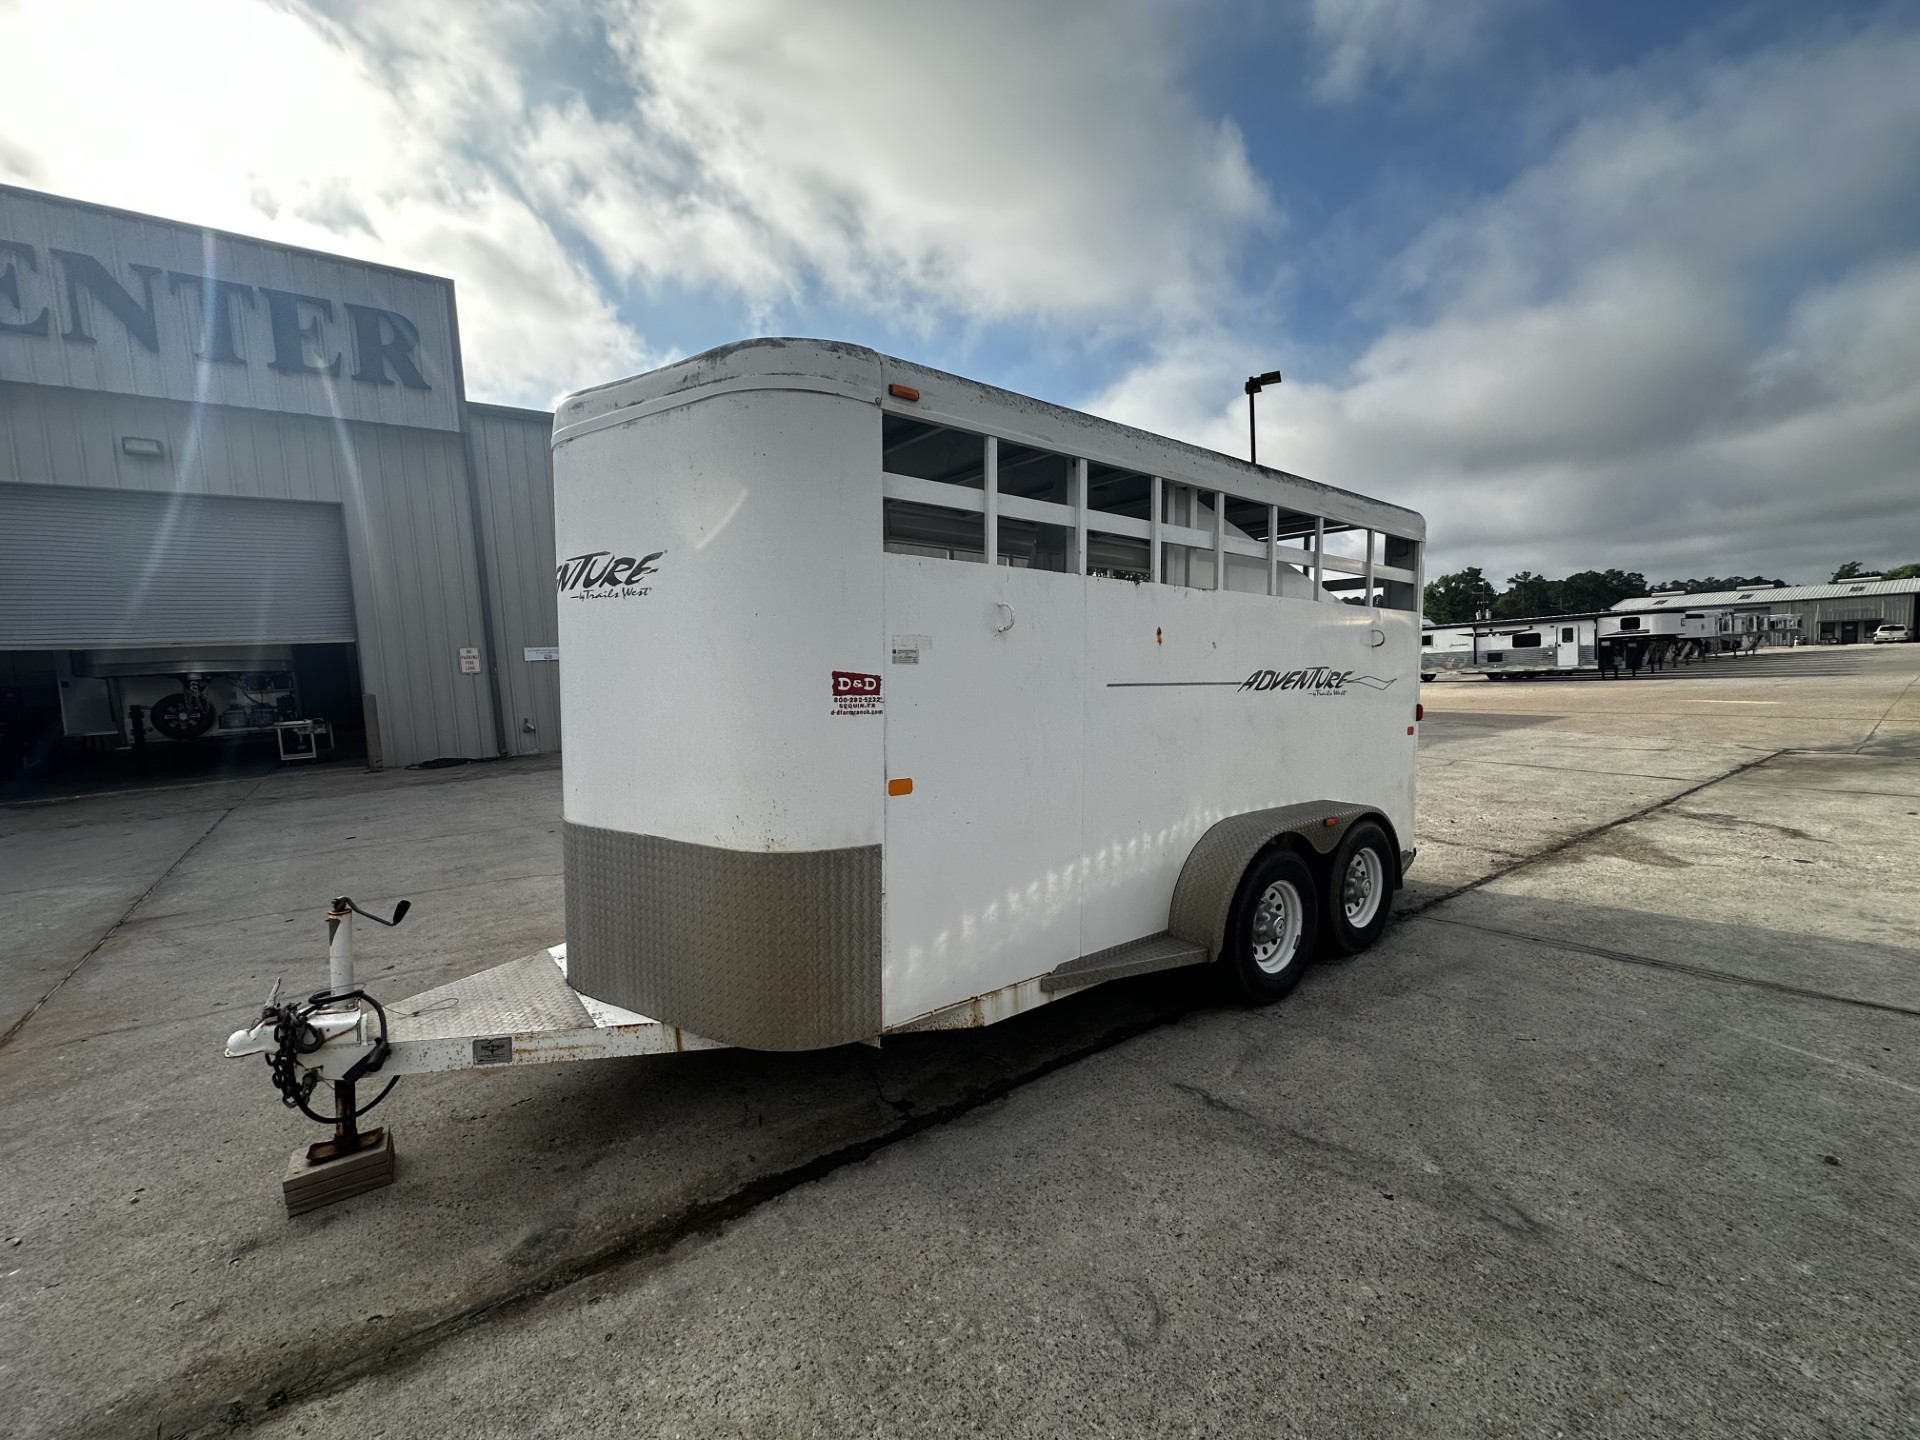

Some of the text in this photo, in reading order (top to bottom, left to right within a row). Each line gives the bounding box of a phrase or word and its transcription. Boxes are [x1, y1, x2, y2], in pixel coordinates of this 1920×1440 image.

[556, 551, 664, 592] NTURE
[583, 589, 619, 599] Trails
[622, 587, 649, 599] West
[1237, 666, 1354, 692] ADVENTURE
